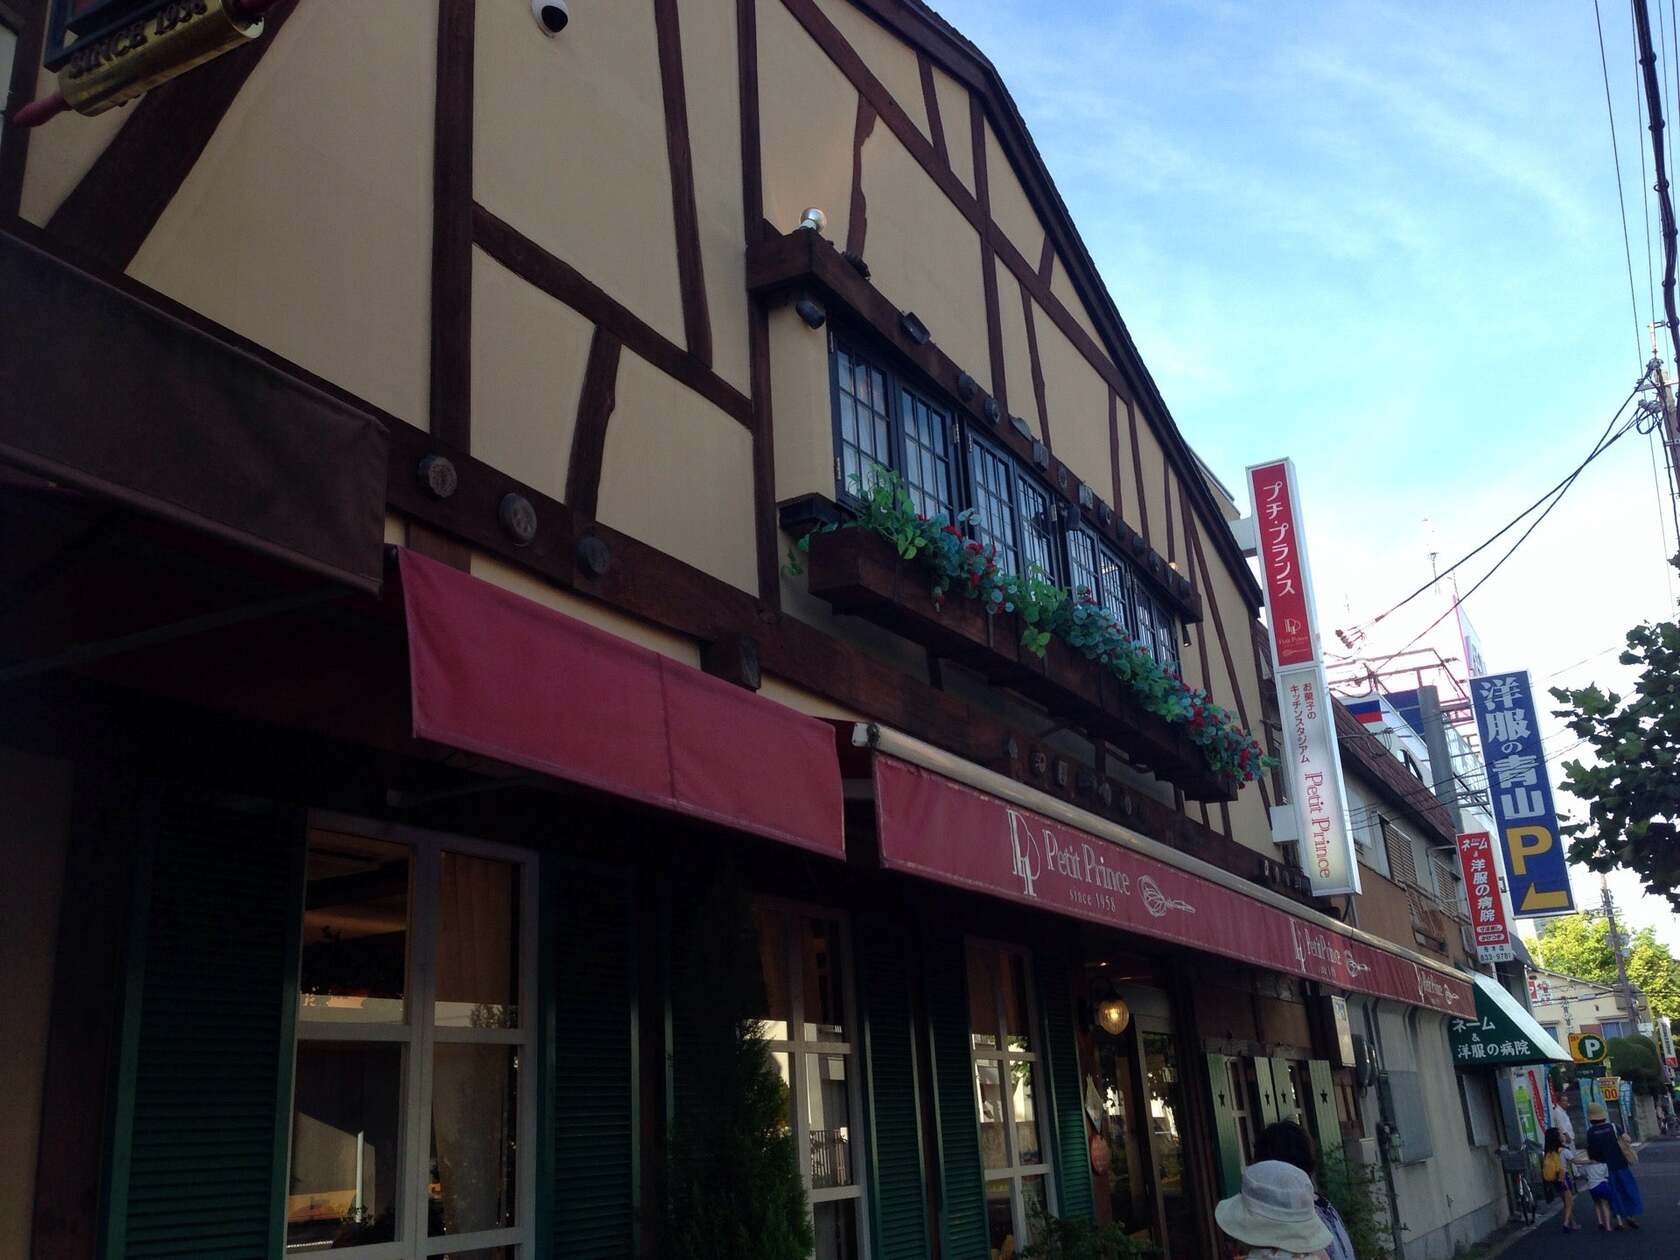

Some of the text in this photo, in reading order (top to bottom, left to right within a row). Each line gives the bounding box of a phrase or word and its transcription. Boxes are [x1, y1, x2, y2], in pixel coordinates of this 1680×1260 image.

[1263, 480, 1296, 597] プチ・プランス
[1479, 676, 1546, 820] 洋服の青山
[1304, 771, 1331, 879] Petit Prince
[1042, 829, 1131, 896] Petit Prince
[1461, 838, 1488, 852] ネーム
[1506, 825, 1553, 876] P
[1069, 889, 1117, 913] since 1958
[1470, 859, 1496, 923] 洋服の病院
[1453, 1016, 1496, 1031] ネーム
[1472, 1033, 1481, 1042] &
[1457, 1040, 1531, 1059] 洋服の病院
[1585, 1039, 1600, 1058] P
